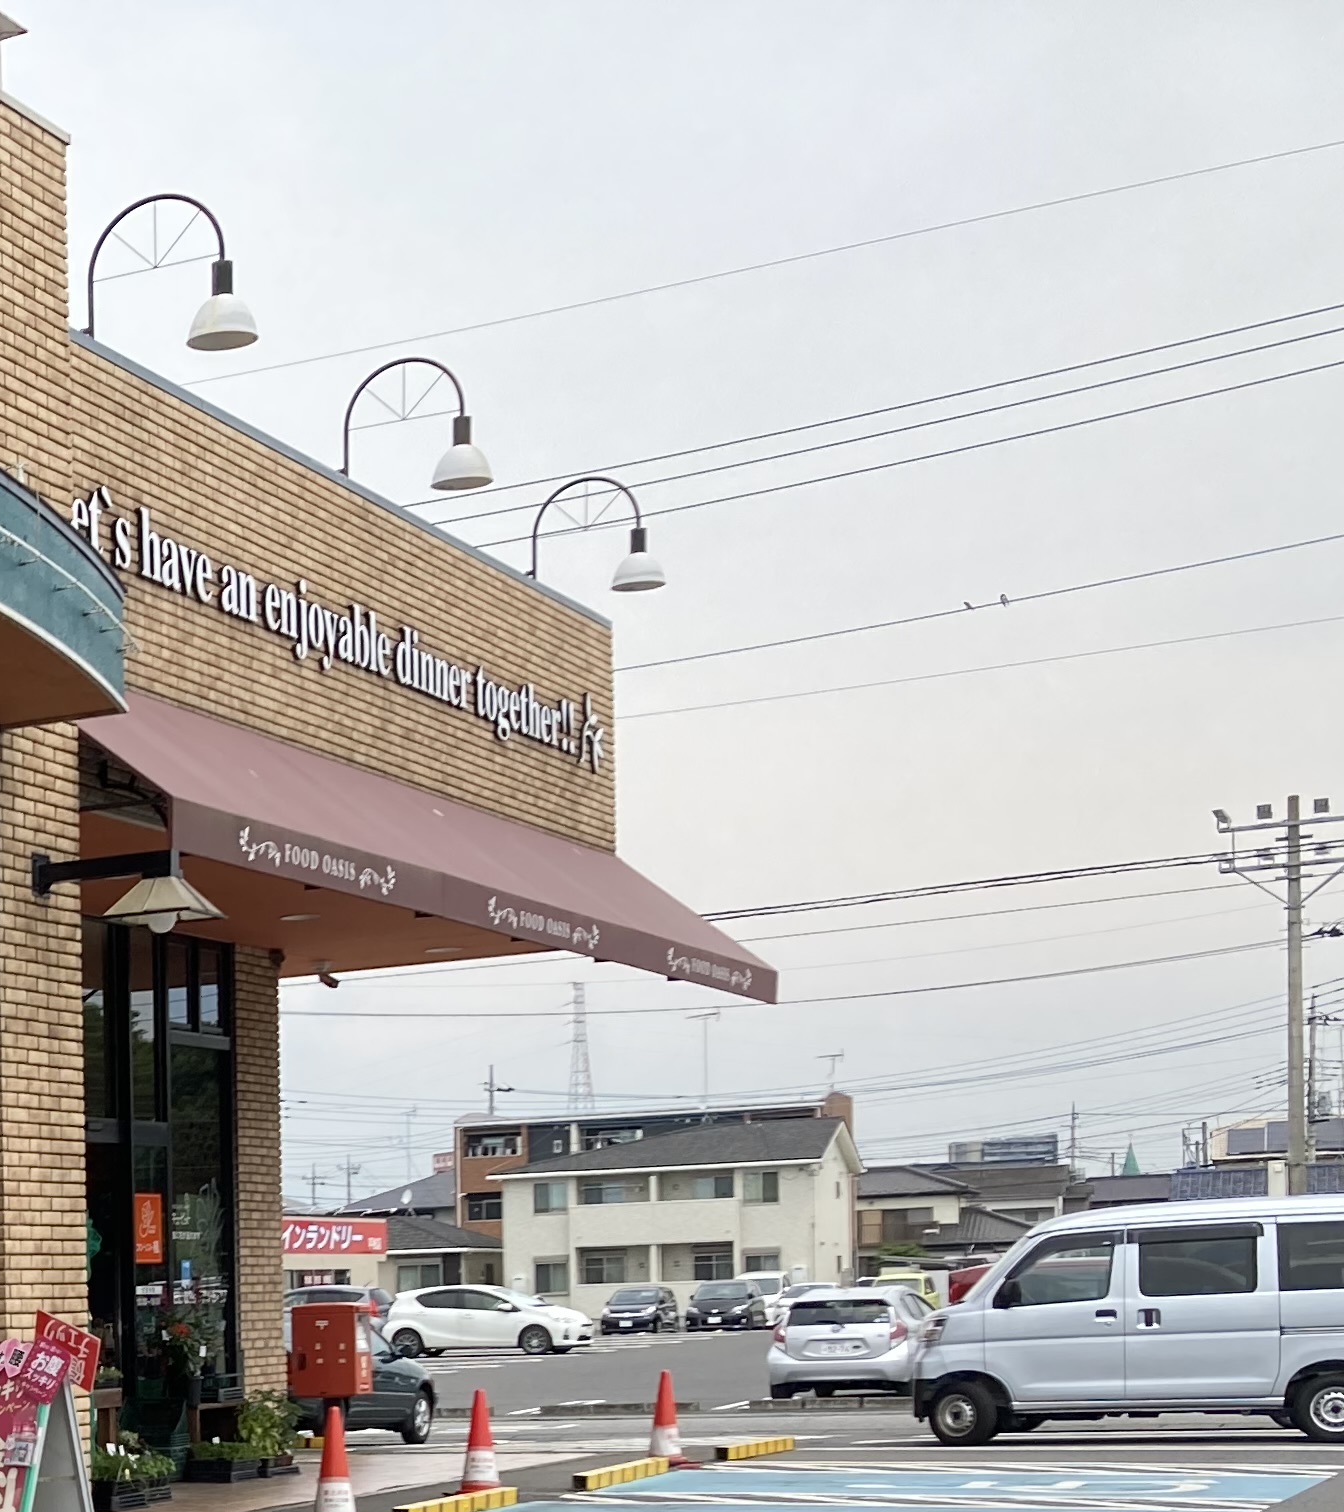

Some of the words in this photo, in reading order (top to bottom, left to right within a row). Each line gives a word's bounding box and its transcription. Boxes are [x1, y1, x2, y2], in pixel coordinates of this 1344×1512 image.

[139, 506, 214, 603] have
[220, 563, 259, 624] an
[264, 578, 392, 674] enjoyable
[395, 625, 473, 712] dinner
[475, 664, 577, 756] together!!
[283, 842, 319, 871] FOOD
[321, 853, 357, 882] OASIS
[519, 909, 545, 932] FOOD
[545, 916, 571, 940] OASIS
[280, 1223, 364, 1250] インランドリー
[21, 1366, 57, 1390] スッキリ
[30, 1350, 66, 1378] お腹
